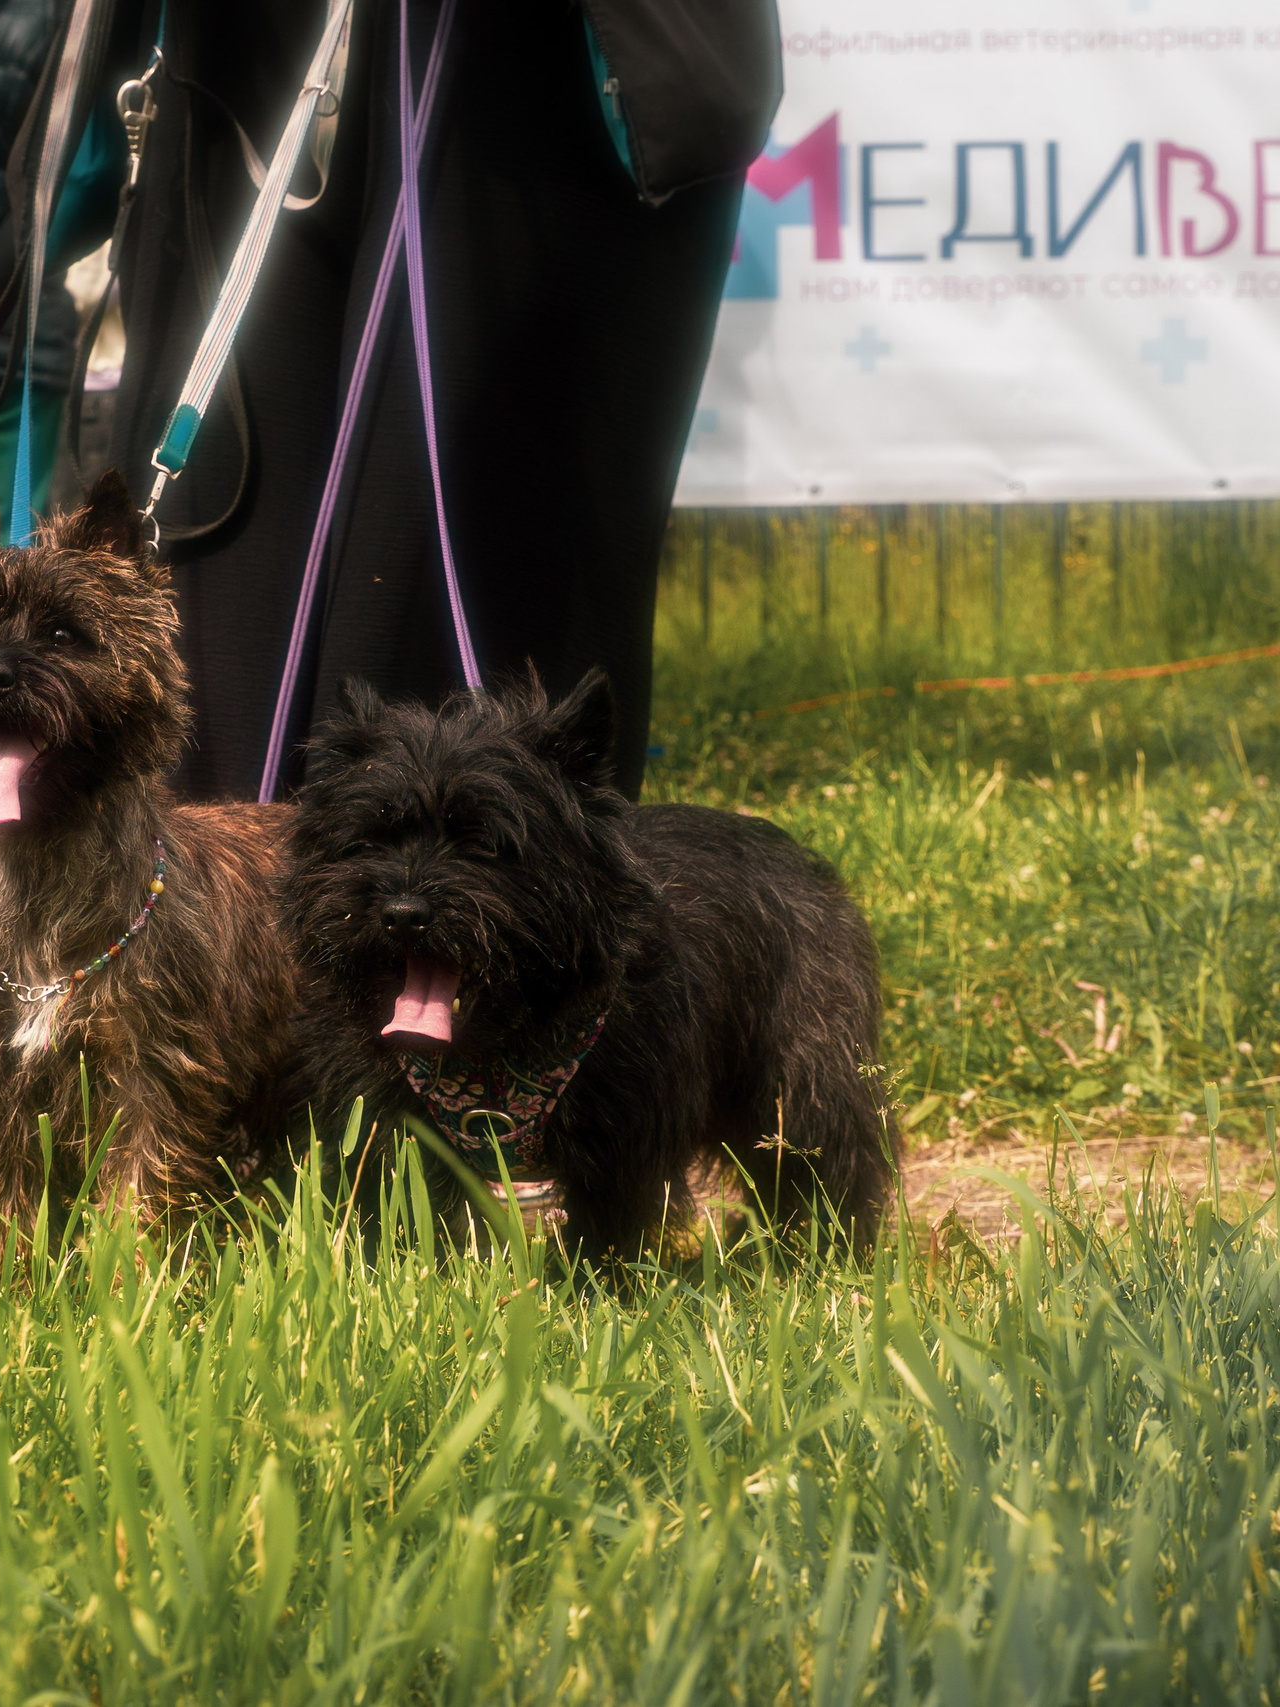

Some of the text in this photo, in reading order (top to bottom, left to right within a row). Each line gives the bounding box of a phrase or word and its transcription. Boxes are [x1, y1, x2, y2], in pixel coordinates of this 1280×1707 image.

[782, 25, 970, 60] офильная
[889, 272, 1092, 308] доверяют
[1102, 271, 1226, 299] самое
